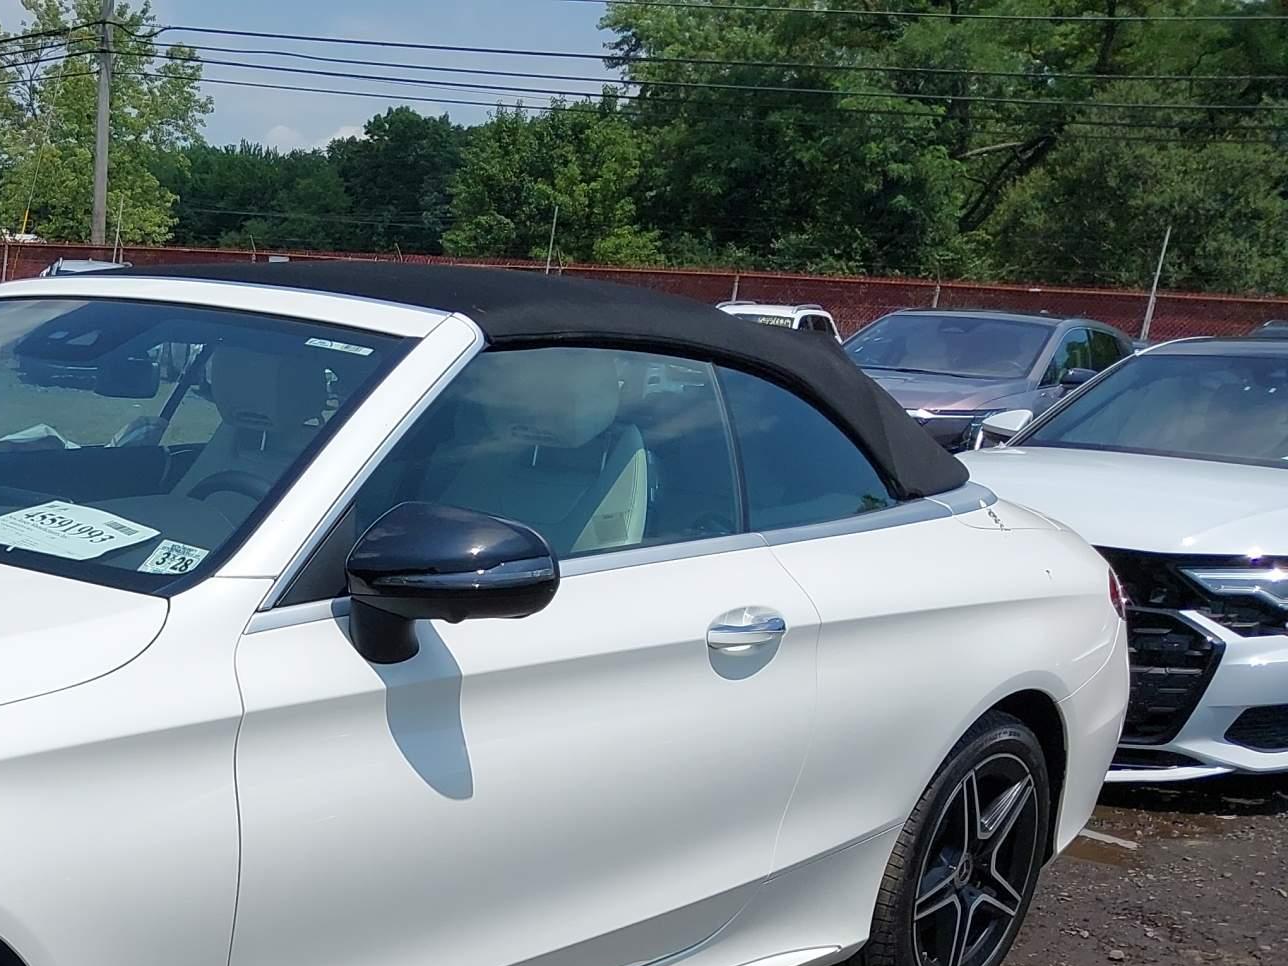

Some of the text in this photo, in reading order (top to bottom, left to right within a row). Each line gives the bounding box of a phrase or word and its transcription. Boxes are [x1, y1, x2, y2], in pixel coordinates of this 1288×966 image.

[24, 511, 115, 544] 45591993
[155, 552, 194, 573] 3 28
